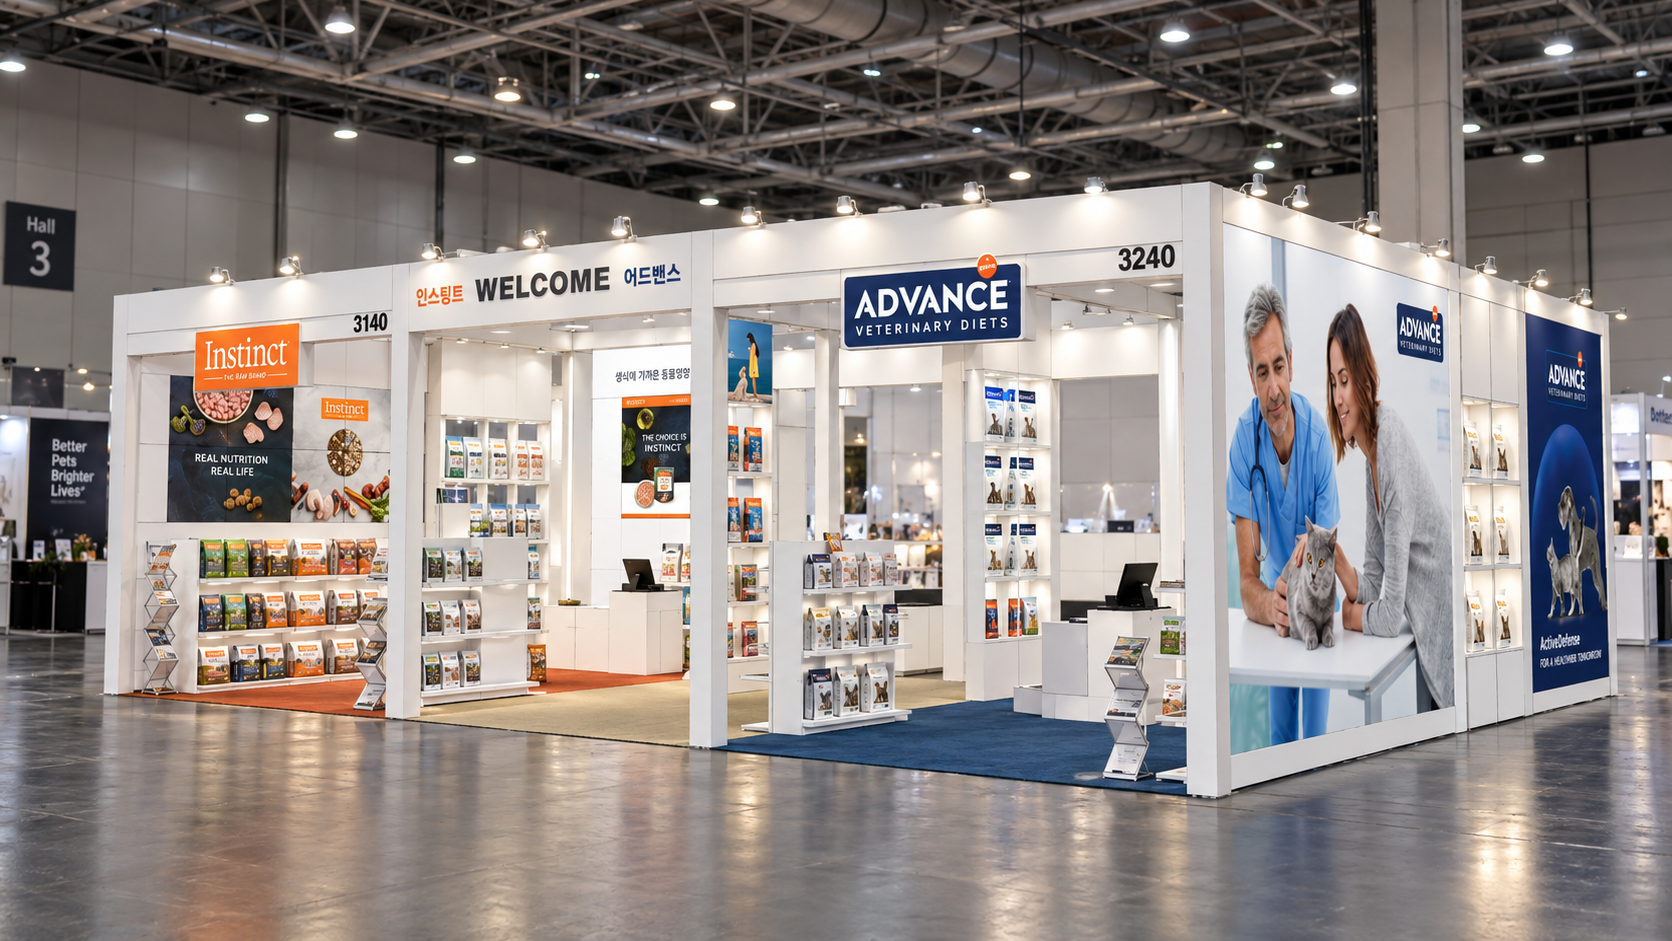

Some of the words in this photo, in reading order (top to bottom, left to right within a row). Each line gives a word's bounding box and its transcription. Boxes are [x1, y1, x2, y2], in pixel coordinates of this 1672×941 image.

[26, 215, 56, 235] Hall
[29, 240, 51, 277] 3
[1118, 244, 1176, 271] 3240
[416, 284, 464, 307] 인스팅트
[474, 266, 610, 302] WELCOME
[624, 263, 681, 287] 어드밴스
[854, 279, 1008, 319] ADVANCE
[353, 312, 388, 333] 3140
[855, 320, 952, 337] VETERINARY
[961, 317, 1009, 331] DIETS
[1399, 315, 1442, 345] ADVANCE
[204, 337, 288, 370] Instinct
[1548, 363, 1586, 391] ADVANCE
[324, 401, 365, 415] Instinct
[52, 438, 88, 453] Better
[642, 433, 655, 442] THE
[655, 433, 679, 442] CHOICE
[680, 432, 687, 441] IS
[644, 443, 682, 453] INSTINCT
[51, 453, 77, 468] Pets
[195, 453, 218, 463] REAL
[220, 454, 269, 465] NUTRITION
[51, 469, 95, 485] Brighter
[210, 467, 234, 476] REAL
[236, 467, 254, 477] LIFE
